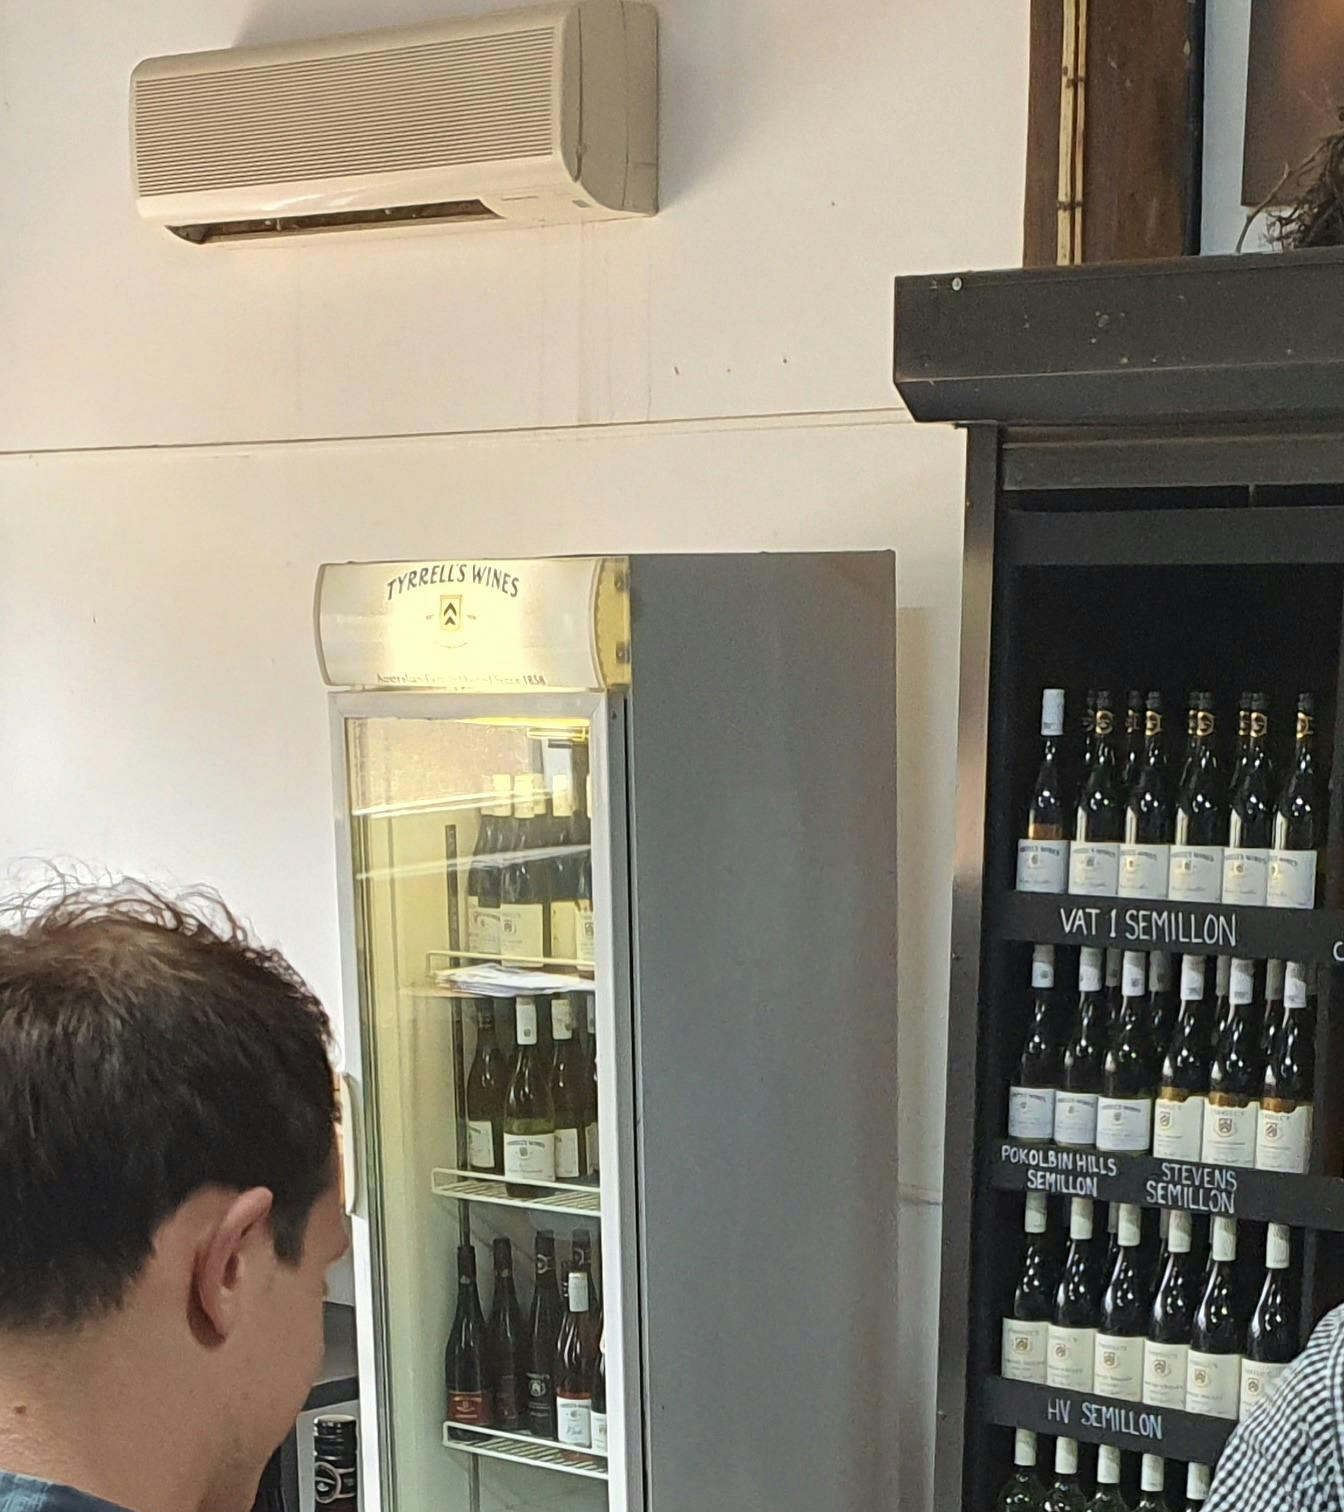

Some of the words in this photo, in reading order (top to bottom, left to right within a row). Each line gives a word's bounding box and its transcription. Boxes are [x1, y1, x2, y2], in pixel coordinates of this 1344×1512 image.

[387, 563, 468, 601] TYRRELL'S
[472, 564, 520, 598] WINES
[1060, 908, 1100, 935] VAT
[1109, 909, 1117, 938] 1
[1125, 909, 1237, 948] SEMILLON
[1001, 1145, 1072, 1170] POKOLBIN
[1076, 1155, 1118, 1177] HILLS
[1161, 1163, 1237, 1191] STEVENS
[1027, 1170, 1098, 1198] SEMILLON
[1146, 1180, 1236, 1213] SEMILLON
[1047, 1398, 1070, 1424] HV
[1081, 1404, 1163, 1441] SEMILLON
